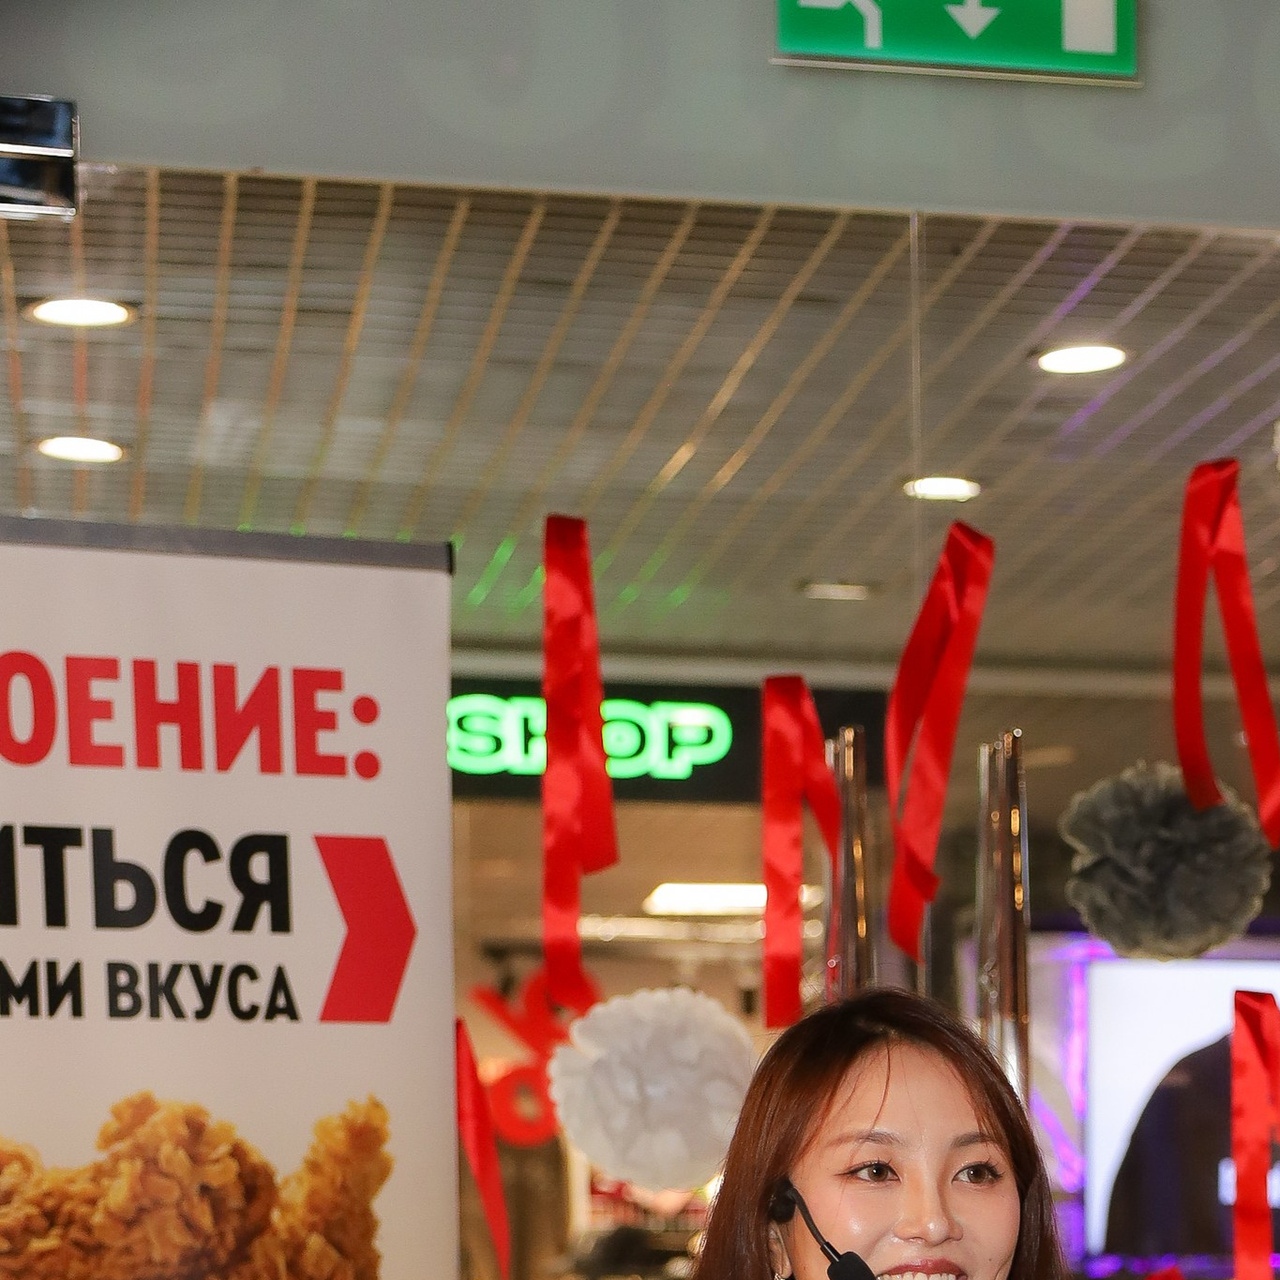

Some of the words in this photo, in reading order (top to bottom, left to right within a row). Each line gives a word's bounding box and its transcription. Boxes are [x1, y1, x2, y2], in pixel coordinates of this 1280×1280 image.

[0, 650, 381, 780] ОЕНИЕ:
[0, 824, 292, 933] ТЬСЯ
[107, 961, 301, 1022] ВКУСА
